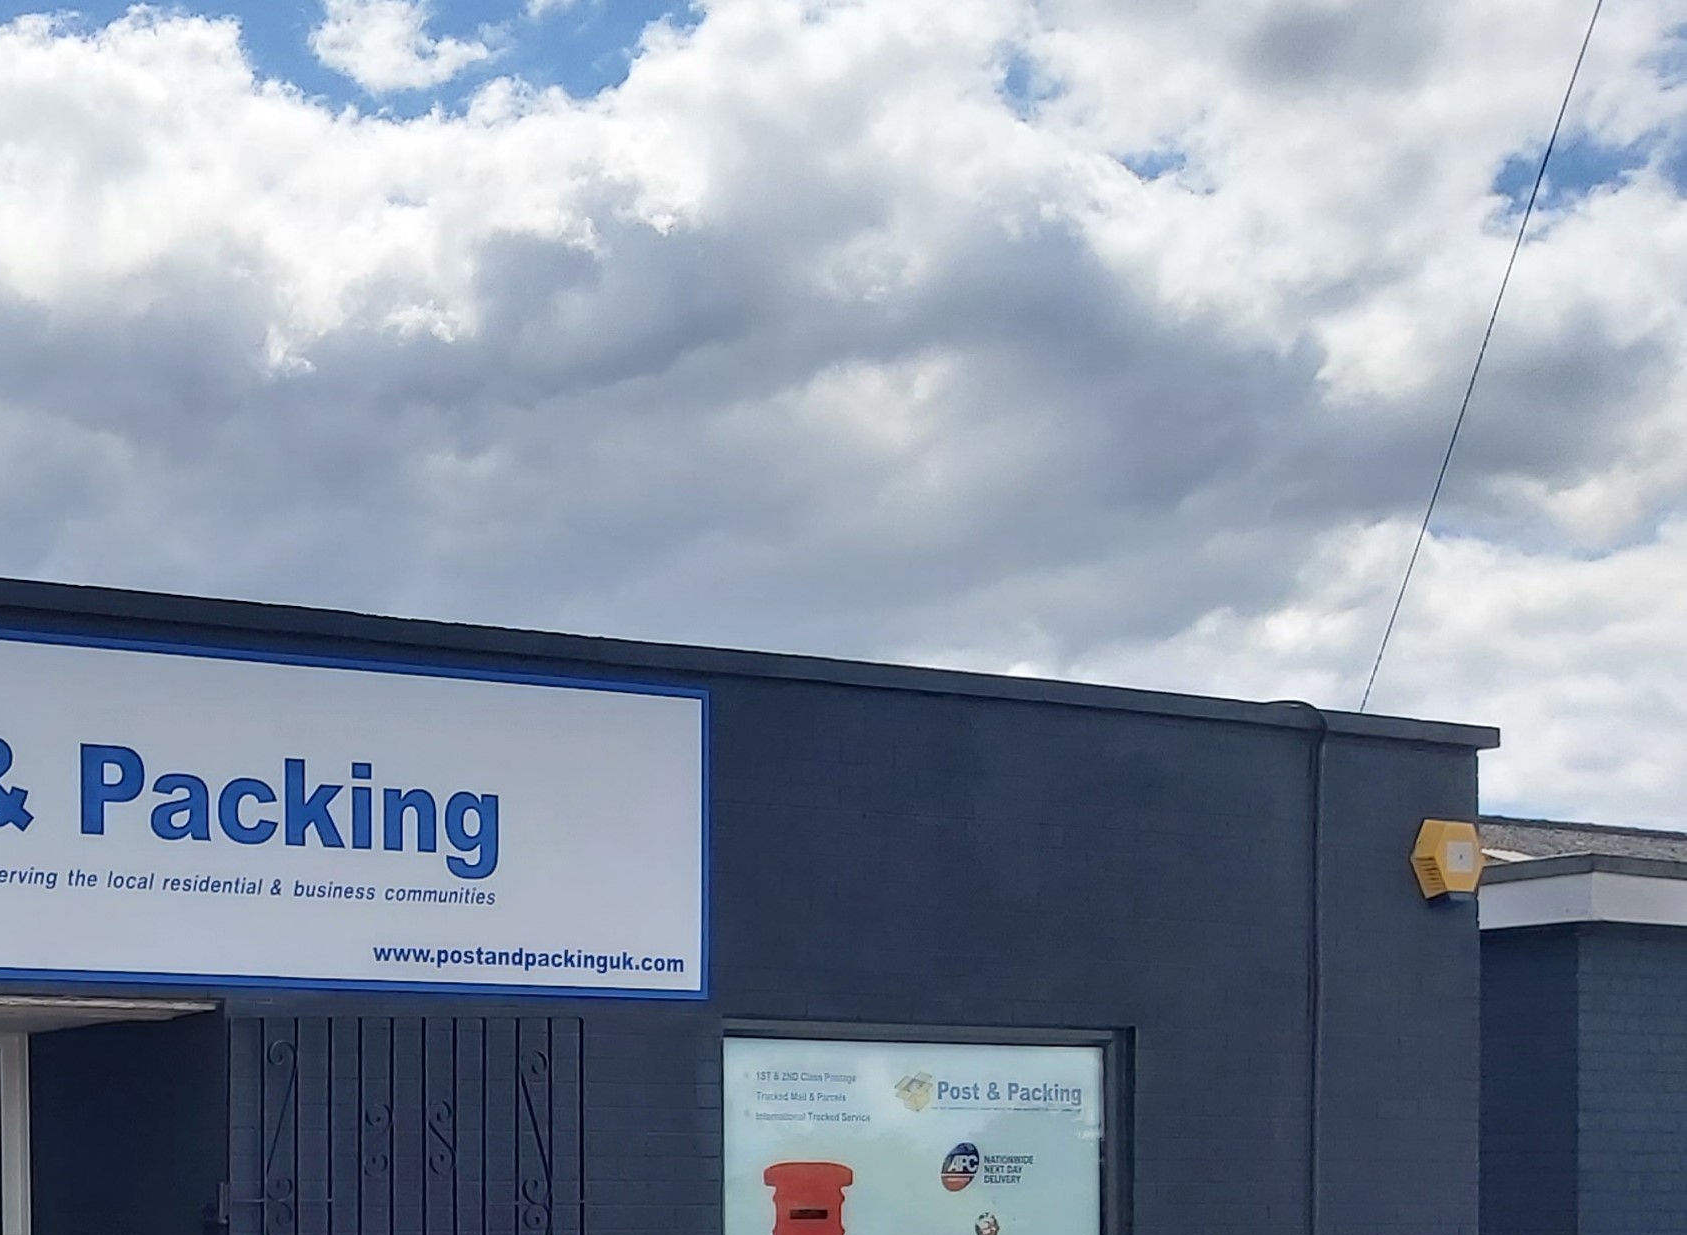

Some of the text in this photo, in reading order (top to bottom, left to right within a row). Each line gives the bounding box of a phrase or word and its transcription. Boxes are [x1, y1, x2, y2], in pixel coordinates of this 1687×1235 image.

[79, 742, 501, 880] Packing
[67, 868, 98, 888] the
[106, 870, 155, 890] local
[161, 873, 263, 896] residential
[269, 878, 282, 896] &
[293, 882, 375, 901] business
[383, 885, 497, 906] communities
[372, 946, 685, 974] www.postandpackinguk.com
[937, 1081, 1082, 1106] Post & Packing
[807, 1112, 839, 1122] Tracked
[947, 1154, 979, 1173] APC
